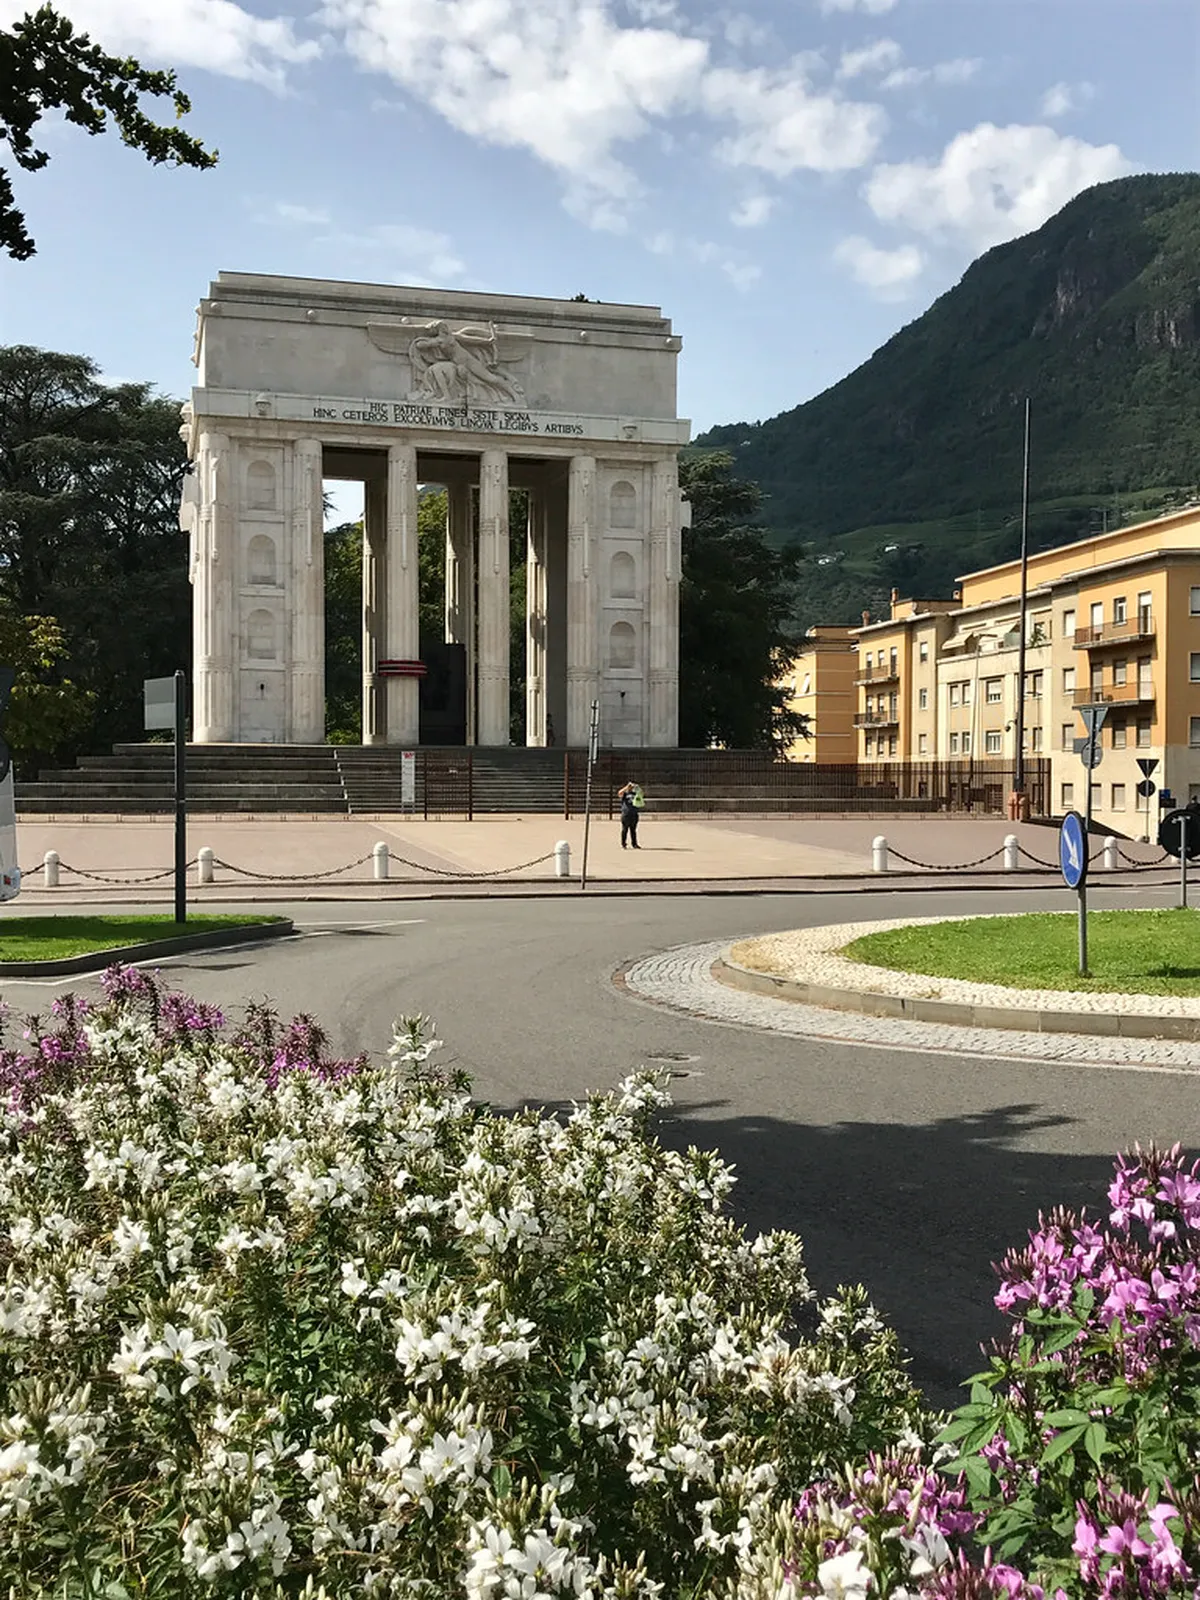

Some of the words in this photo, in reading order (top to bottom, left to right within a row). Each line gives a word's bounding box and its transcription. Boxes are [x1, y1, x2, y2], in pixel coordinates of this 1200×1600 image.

[313, 407, 337, 418] HINC
[342, 410, 389, 422] CETEROS
[544, 423, 584, 435] ARTIBVS
[370, 402, 389, 412] HIC
[393, 404, 433, 416] PATRIAE
[473, 409, 498, 421] SISTE
[504, 412, 531, 422] SIGNA
